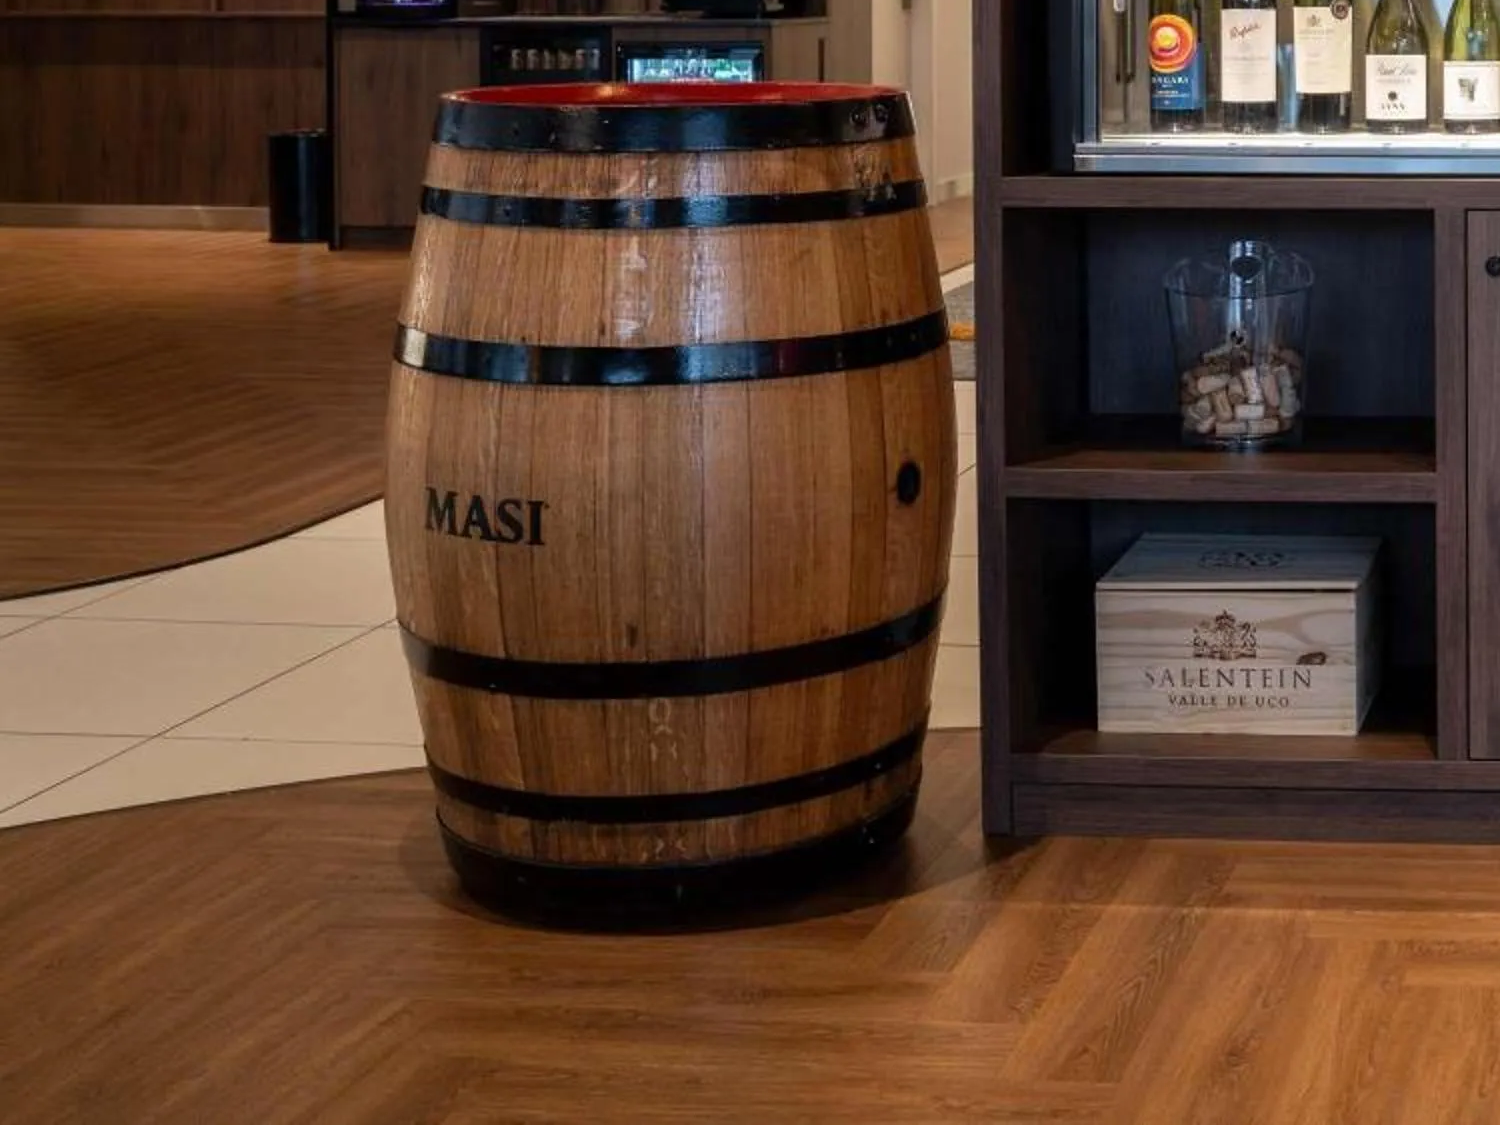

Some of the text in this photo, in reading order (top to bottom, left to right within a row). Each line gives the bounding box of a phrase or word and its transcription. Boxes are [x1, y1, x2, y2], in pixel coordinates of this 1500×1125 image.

[424, 486, 546, 546] MASI
[1145, 668, 1312, 690] SALENTEIN
[1168, 694, 1217, 707] VALLE
